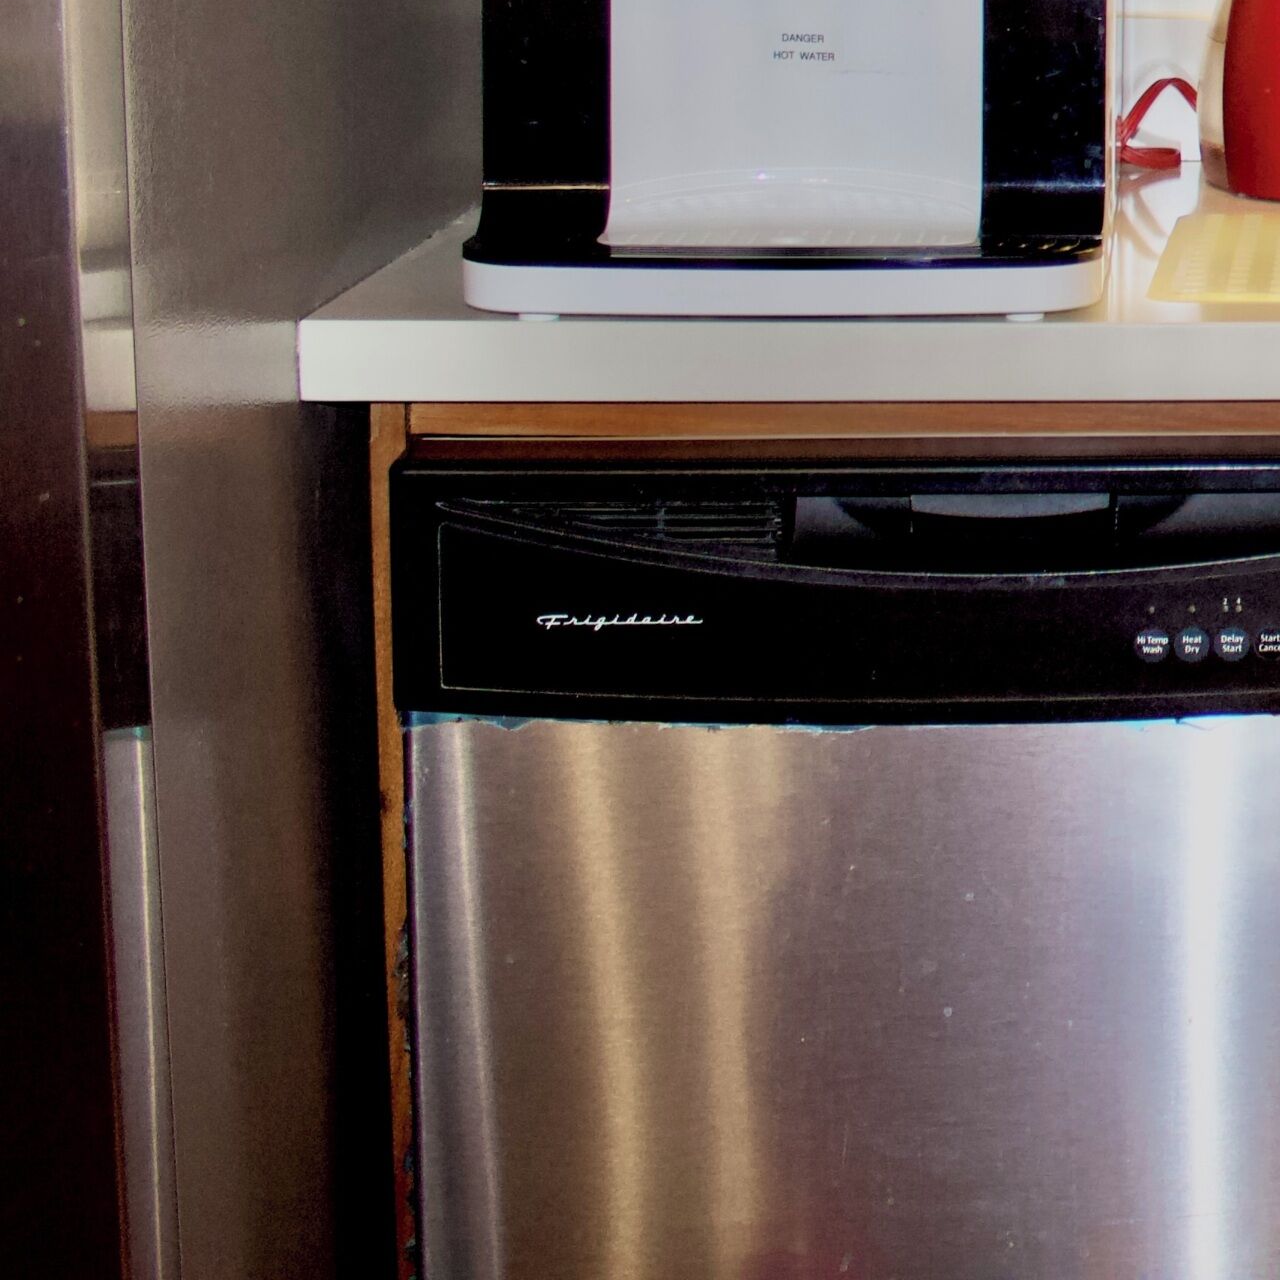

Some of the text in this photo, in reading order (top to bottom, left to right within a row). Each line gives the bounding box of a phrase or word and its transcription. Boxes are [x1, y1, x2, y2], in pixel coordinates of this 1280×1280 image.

[781, 33, 825, 43] DANGER
[773, 50, 835, 61] HOT WATER
[536, 613, 703, 631] Frigidaire
[1137, 636, 1168, 646] Hi Temp
[1182, 635, 1202, 644] Heat
[1220, 634, 1244, 645] Delay
[1142, 645, 1163, 654] Wash
[1184, 645, 1200, 655] Dry
[1222, 644, 1242, 653] Start
